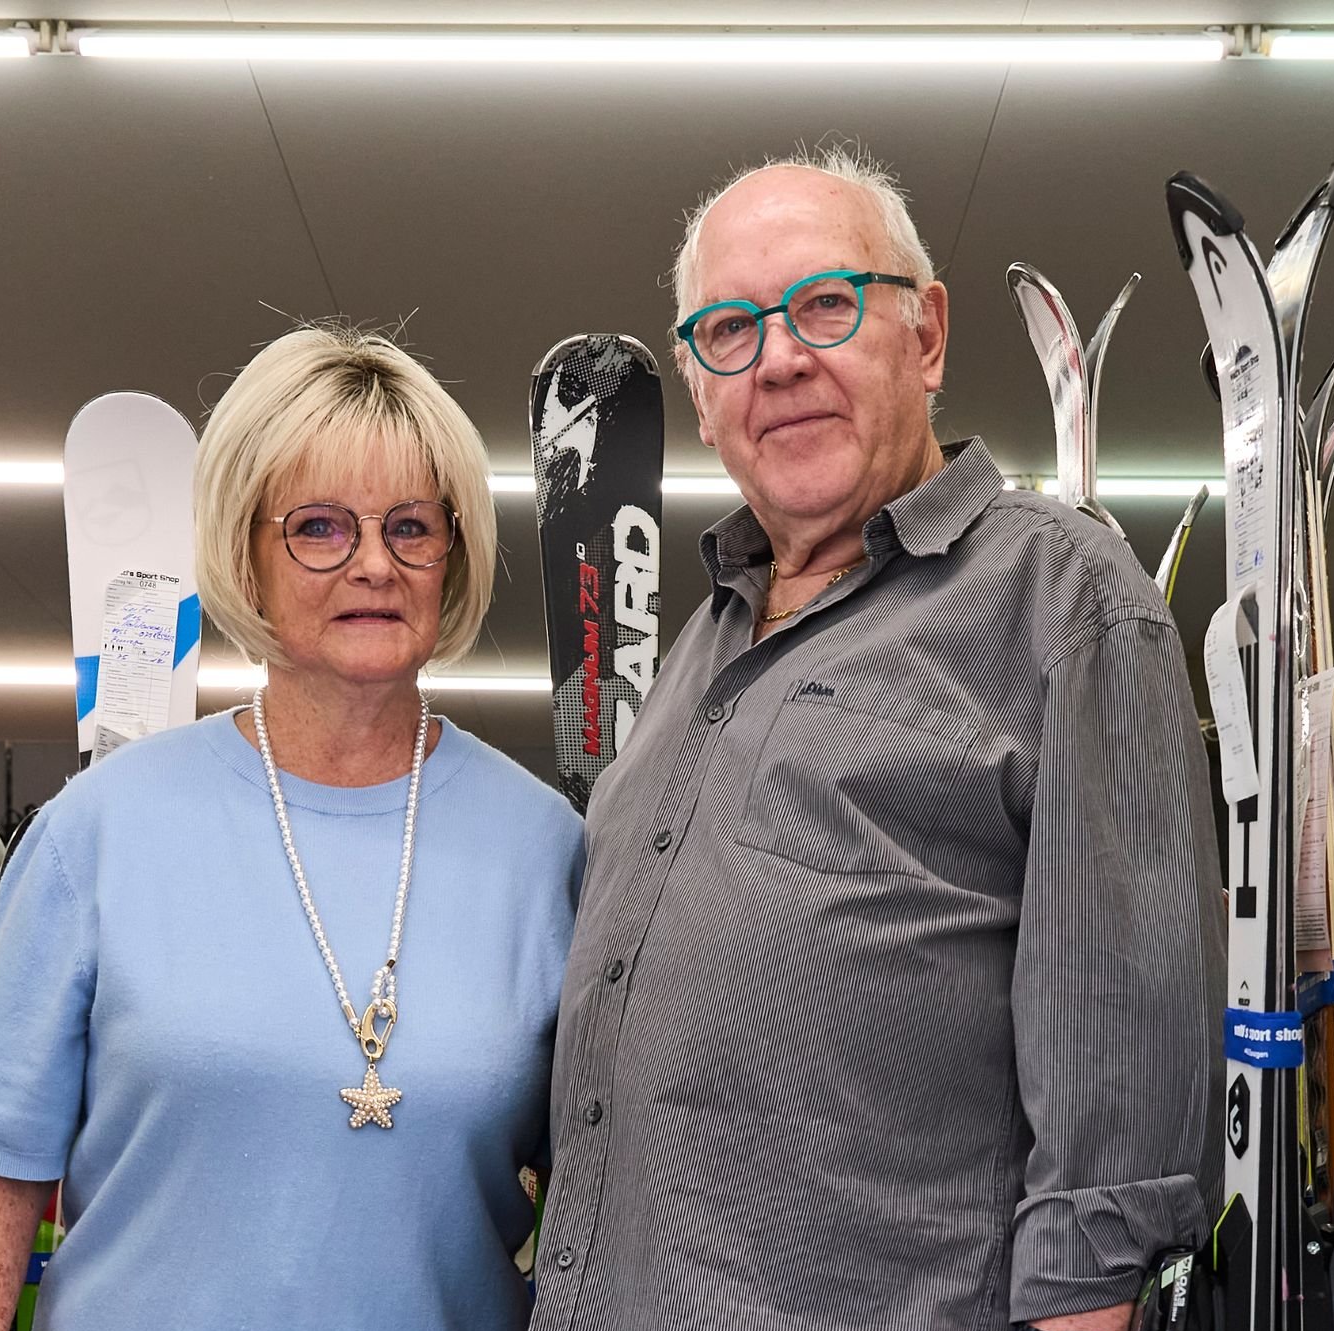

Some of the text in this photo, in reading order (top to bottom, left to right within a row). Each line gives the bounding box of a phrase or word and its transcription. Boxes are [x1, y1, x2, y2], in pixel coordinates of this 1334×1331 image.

[135, 571, 158, 581] Sport
[160, 574, 180, 584] Shop
[582, 619, 601, 757] MAGNUM
[1275, 1027, 1304, 1042] shop
[1177, 1276, 1188, 1307] EVO
